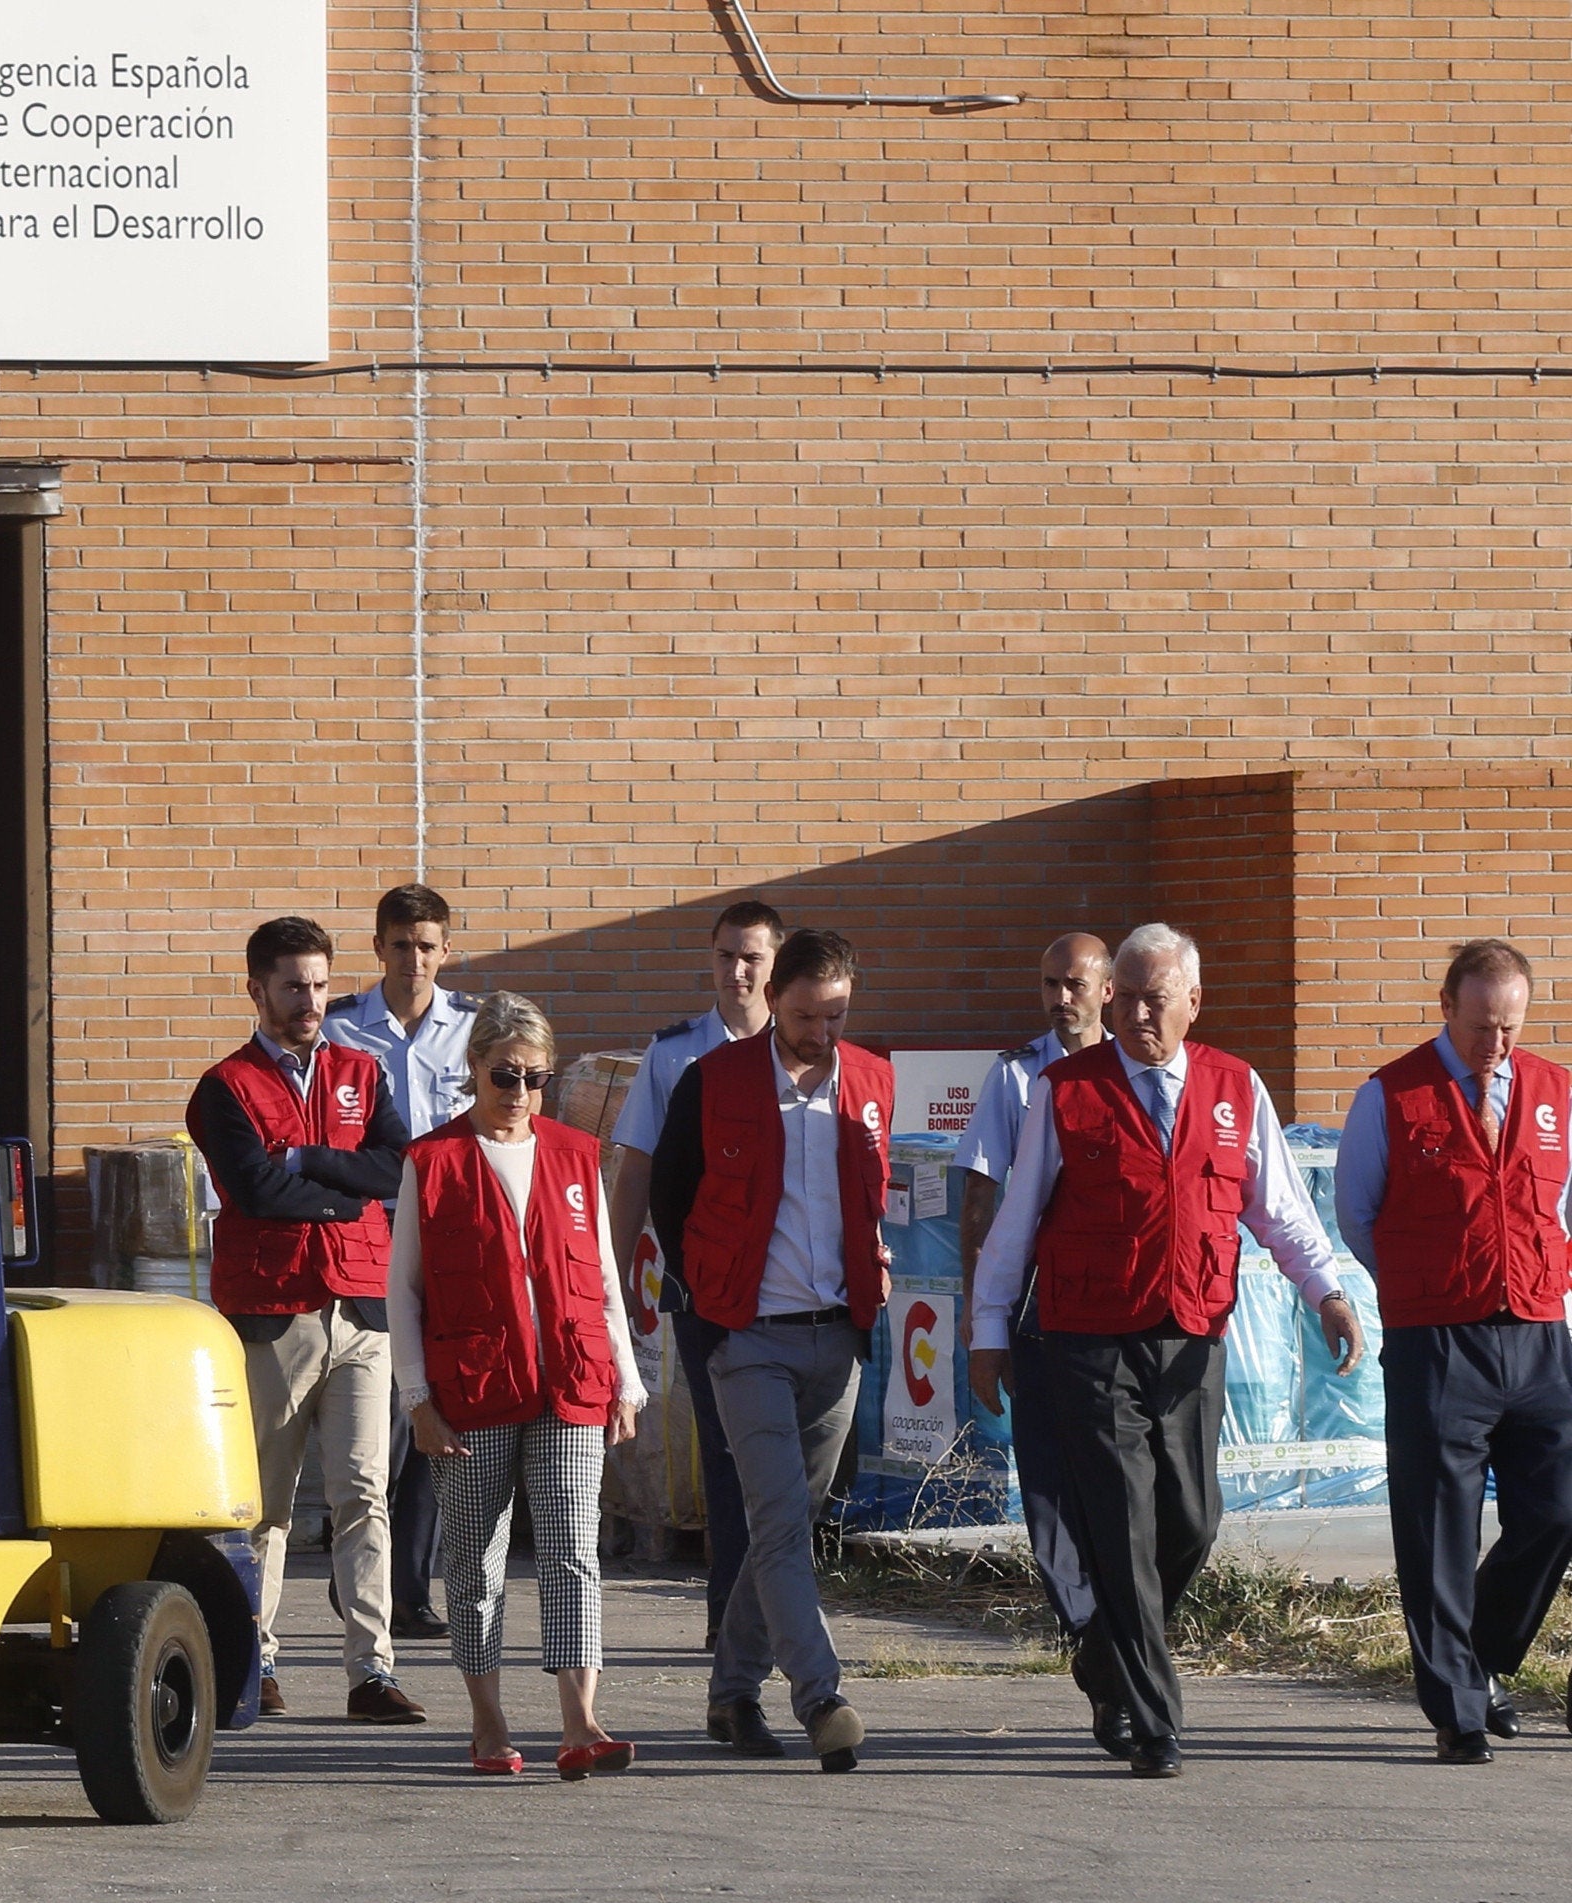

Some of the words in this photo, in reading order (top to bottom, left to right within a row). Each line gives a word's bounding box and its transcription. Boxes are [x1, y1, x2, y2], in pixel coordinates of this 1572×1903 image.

[111, 52, 250, 99] Española
[21, 101, 234, 150] Cooperación
[52, 203, 78, 239] el
[92, 203, 264, 240] Desarrollo
[947, 1086, 970, 1100] USO
[928, 1102, 977, 1115] EXCLUSI
[927, 1117, 970, 1131] BOMBE
